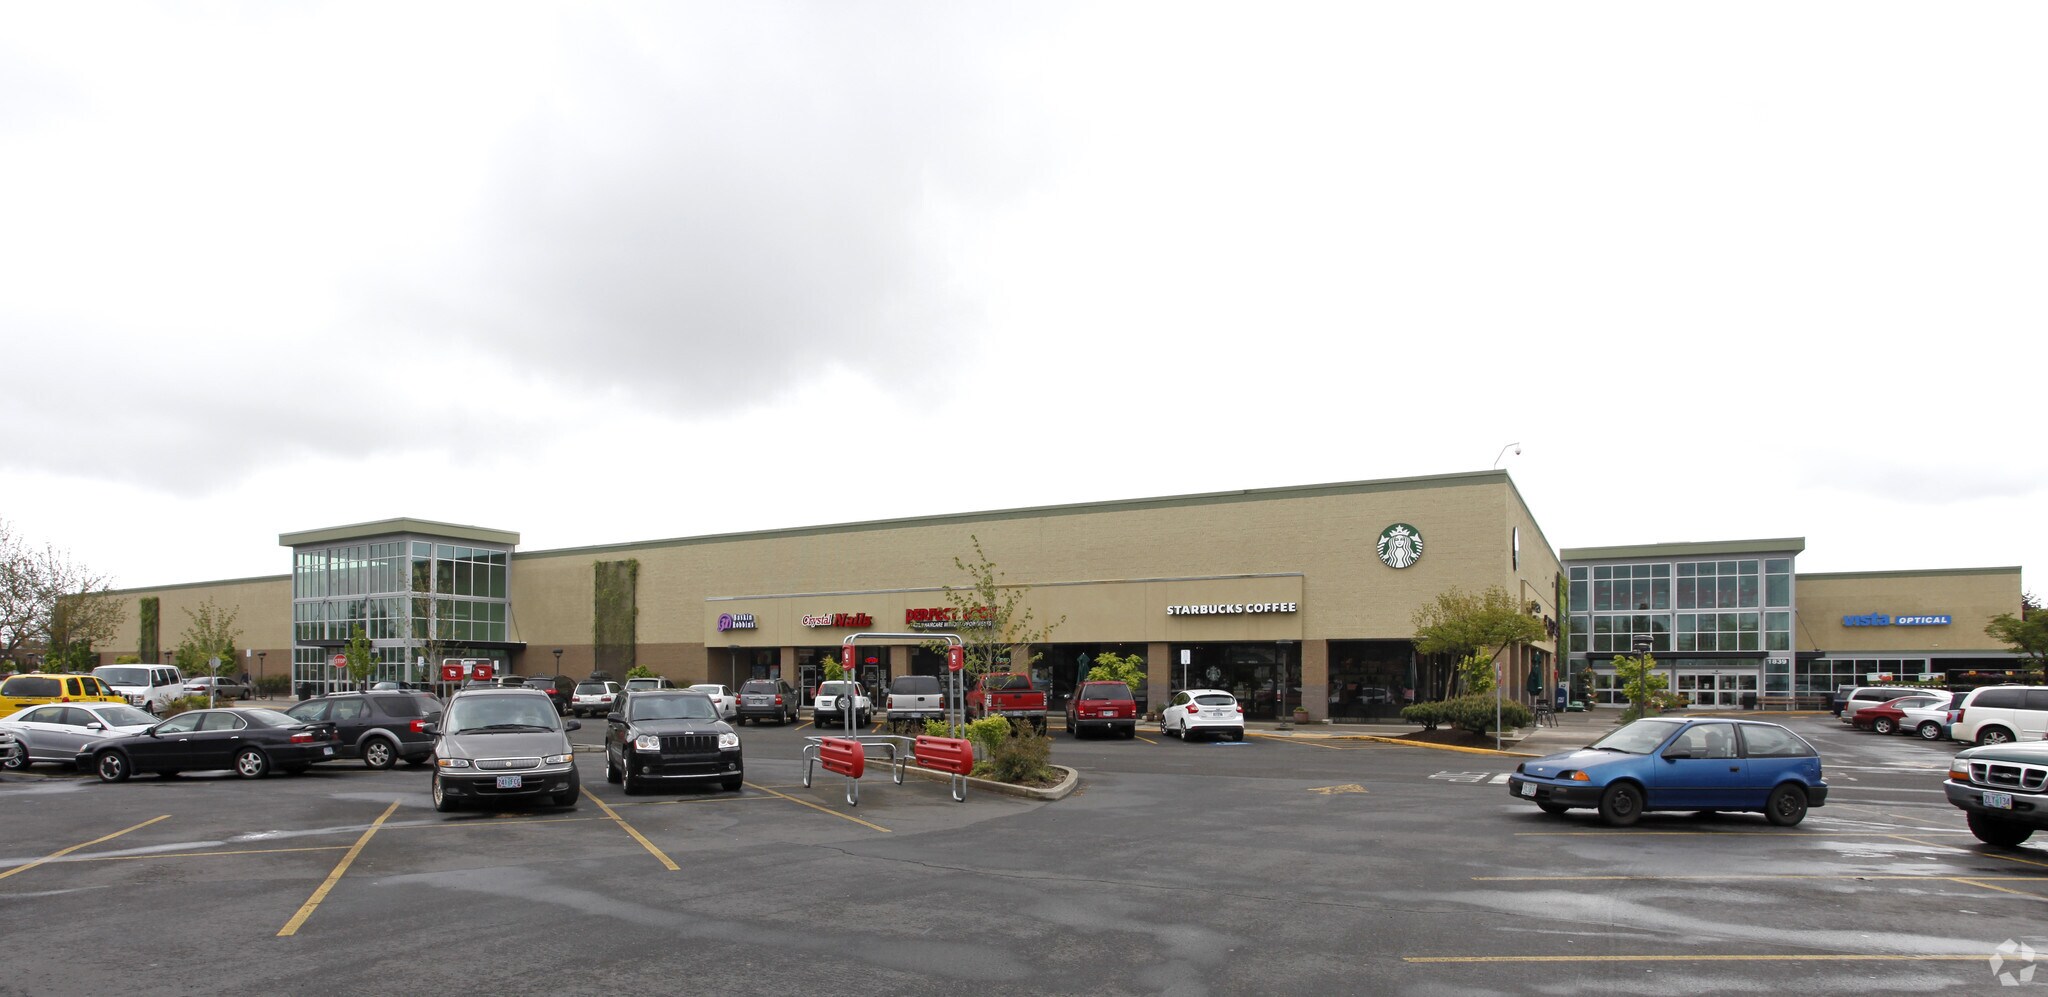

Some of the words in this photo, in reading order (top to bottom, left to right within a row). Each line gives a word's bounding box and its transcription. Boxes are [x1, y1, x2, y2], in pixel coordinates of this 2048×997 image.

[1166, 603, 1243, 615] STARBUCKS
[1245, 602, 1296, 613] COFFEE
[802, 613, 833, 627] Crystal
[833, 612, 872, 627] Nails
[1842, 612, 1890, 627] vista
[1898, 616, 1948, 624] OPTICAL
